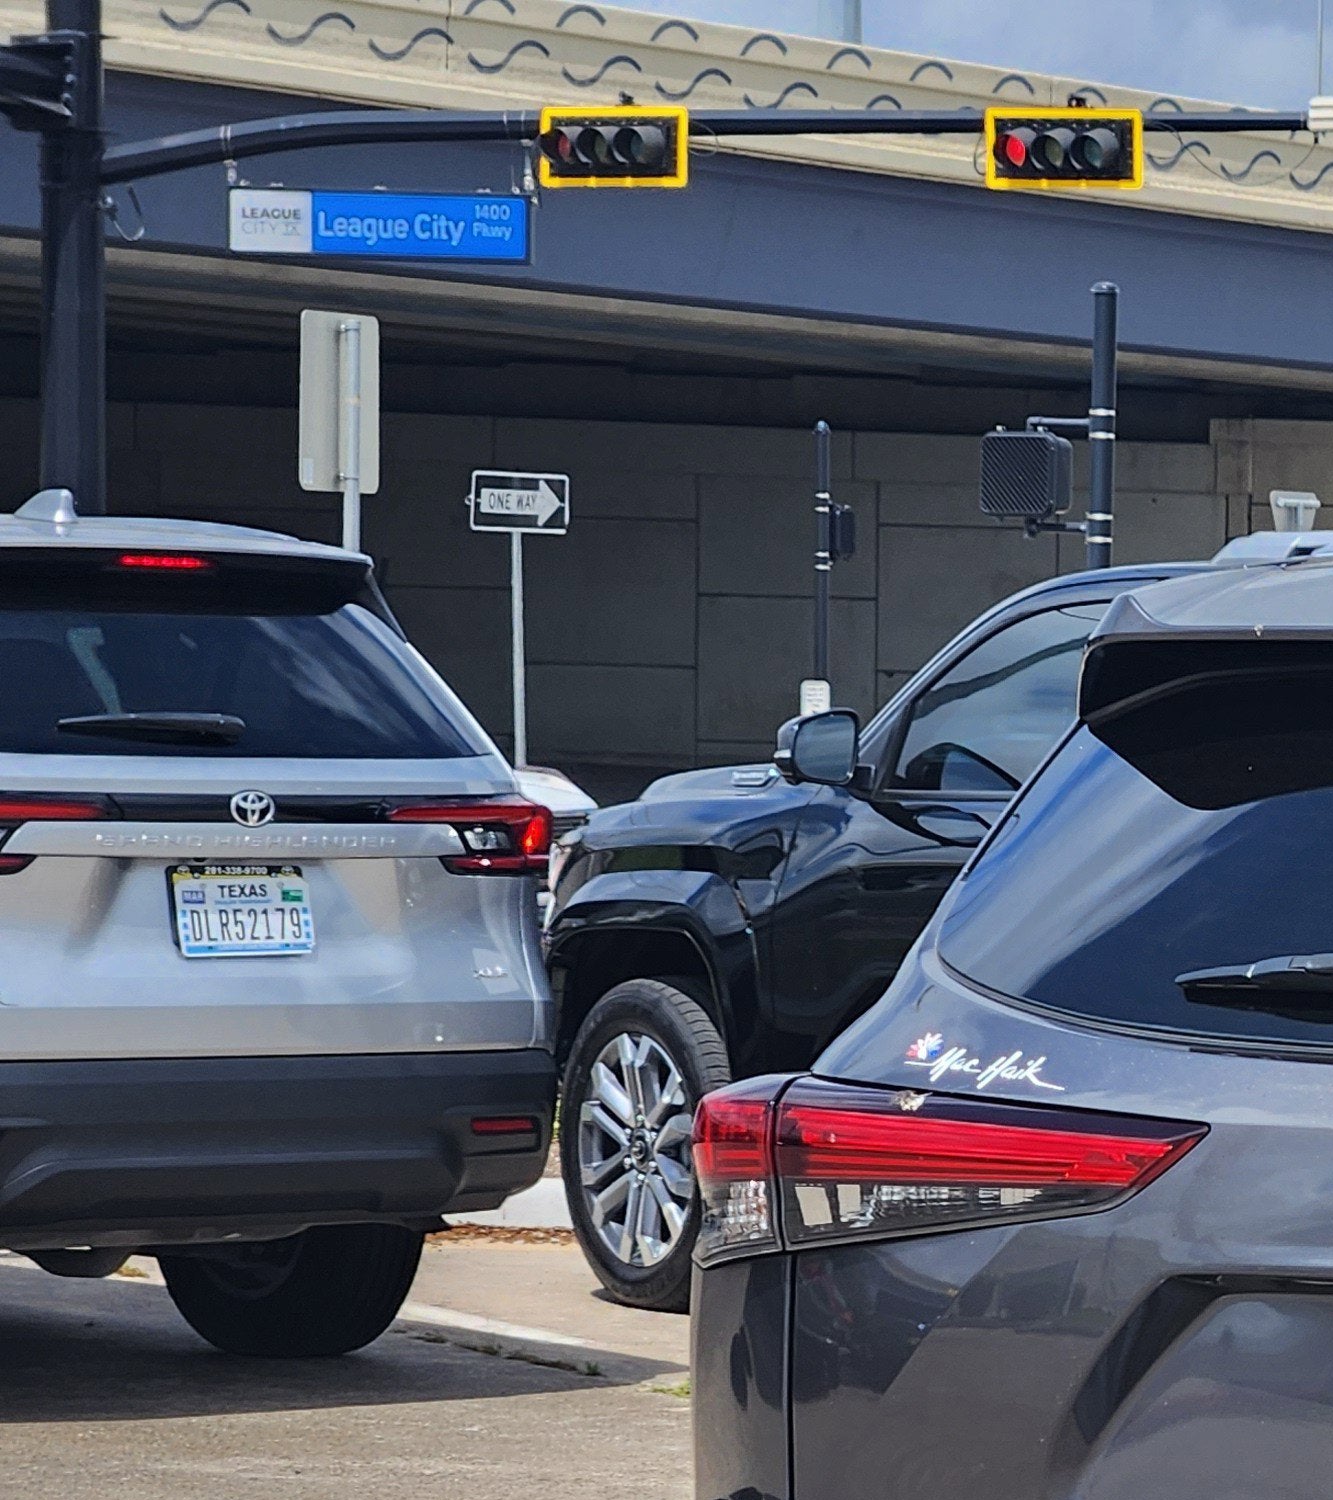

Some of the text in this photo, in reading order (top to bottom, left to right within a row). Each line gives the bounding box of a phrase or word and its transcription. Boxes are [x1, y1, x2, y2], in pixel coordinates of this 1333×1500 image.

[241, 206, 302, 220] LEAGUE
[474, 204, 511, 221] 1400
[317, 210, 466, 247] League City
[472, 222, 513, 242] Pkwy
[488, 492, 538, 513] ONE WAY
[217, 884, 268, 898] TEXAS
[190, 907, 302, 942] DLR52179
